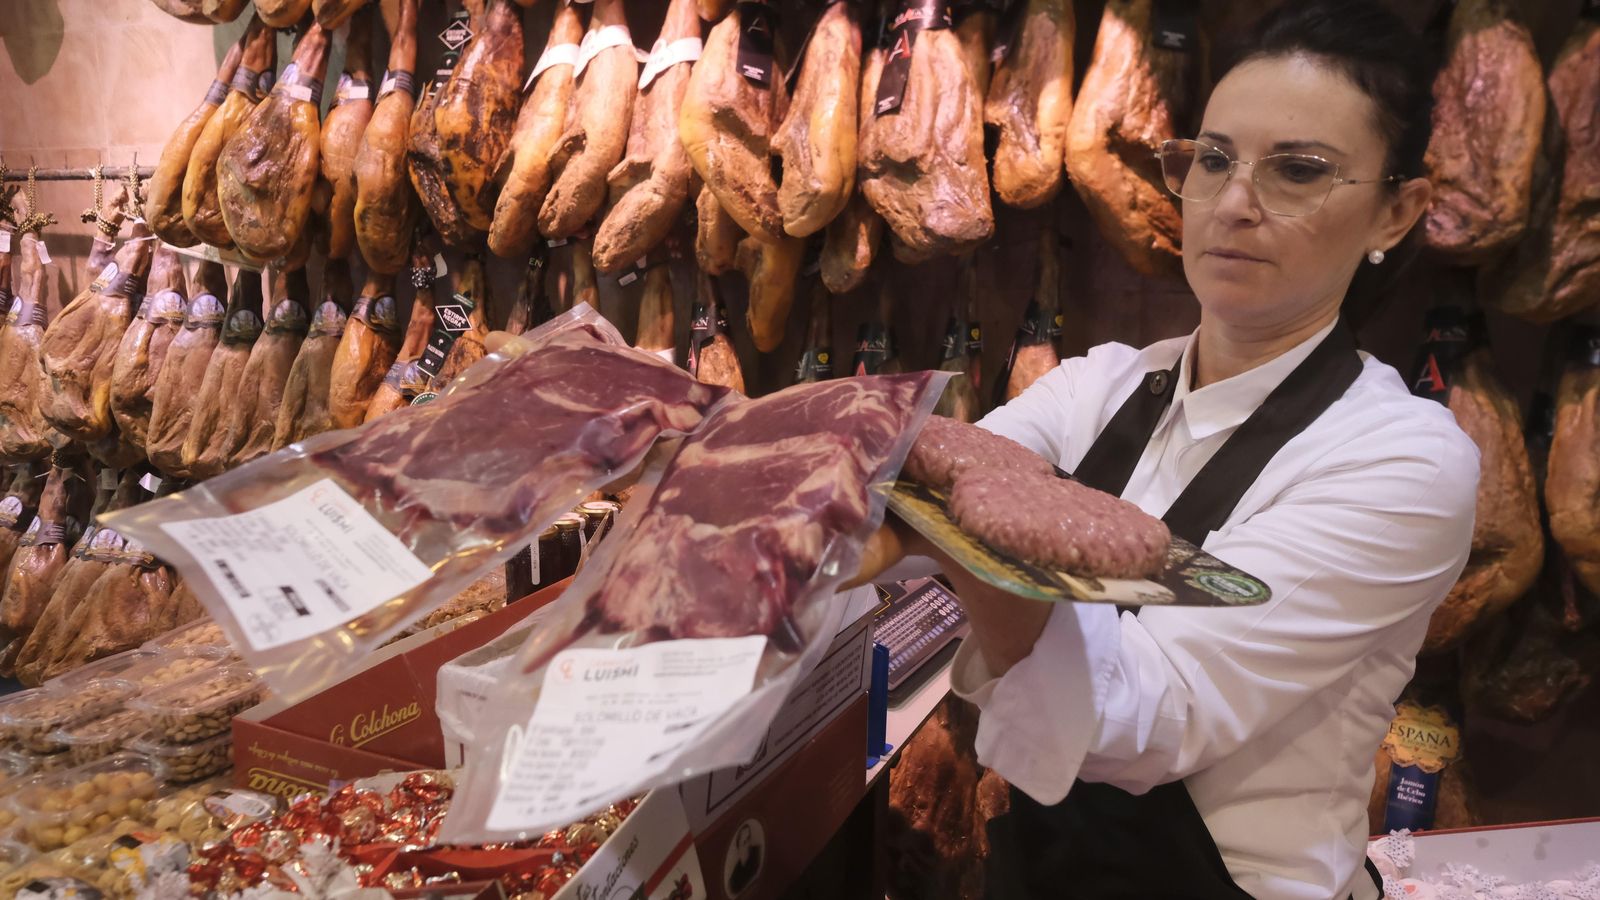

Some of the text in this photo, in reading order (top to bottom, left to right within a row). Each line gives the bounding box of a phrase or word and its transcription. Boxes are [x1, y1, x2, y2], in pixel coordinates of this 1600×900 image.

[442, 313, 462, 328] NEGRA
[443, 307, 467, 325] ESTIRPE
[1414, 353, 1447, 393] A
[584, 665, 639, 682] LUISMI
[330, 702, 421, 745] La Colchona
[1396, 785, 1426, 798] de Cebo
